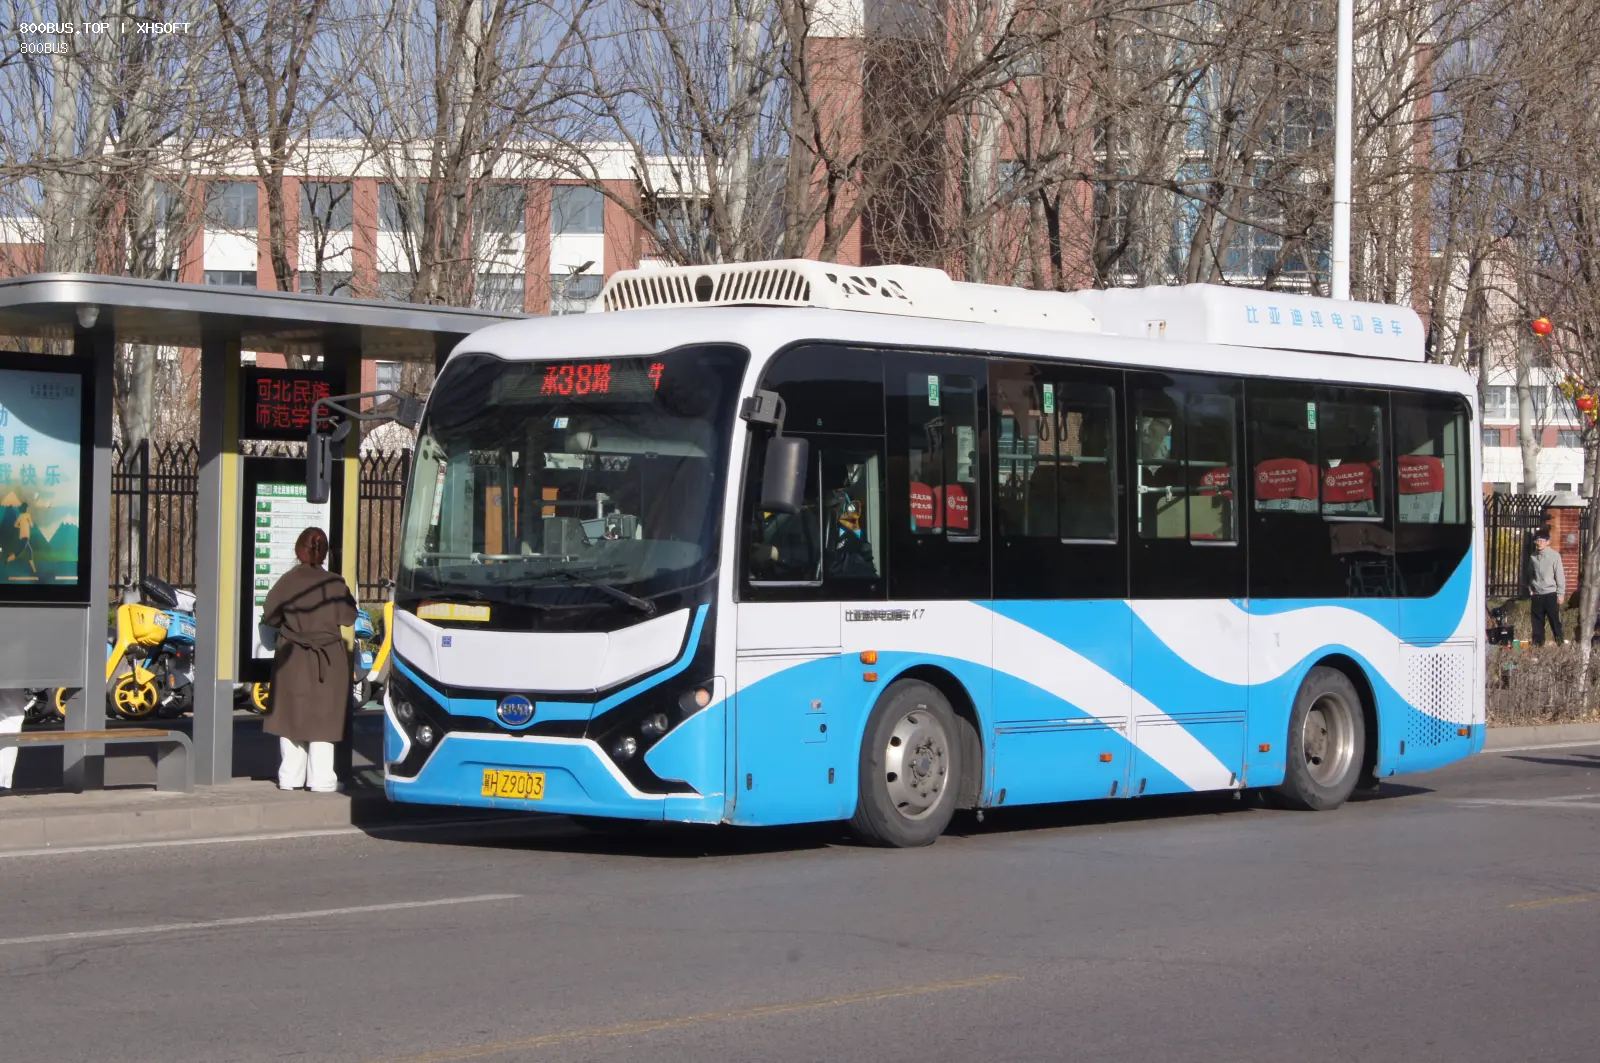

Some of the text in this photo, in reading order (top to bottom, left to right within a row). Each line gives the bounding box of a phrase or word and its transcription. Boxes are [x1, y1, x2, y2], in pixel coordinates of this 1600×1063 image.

[1245, 305, 1402, 336] 比亚迪纯电动客车
